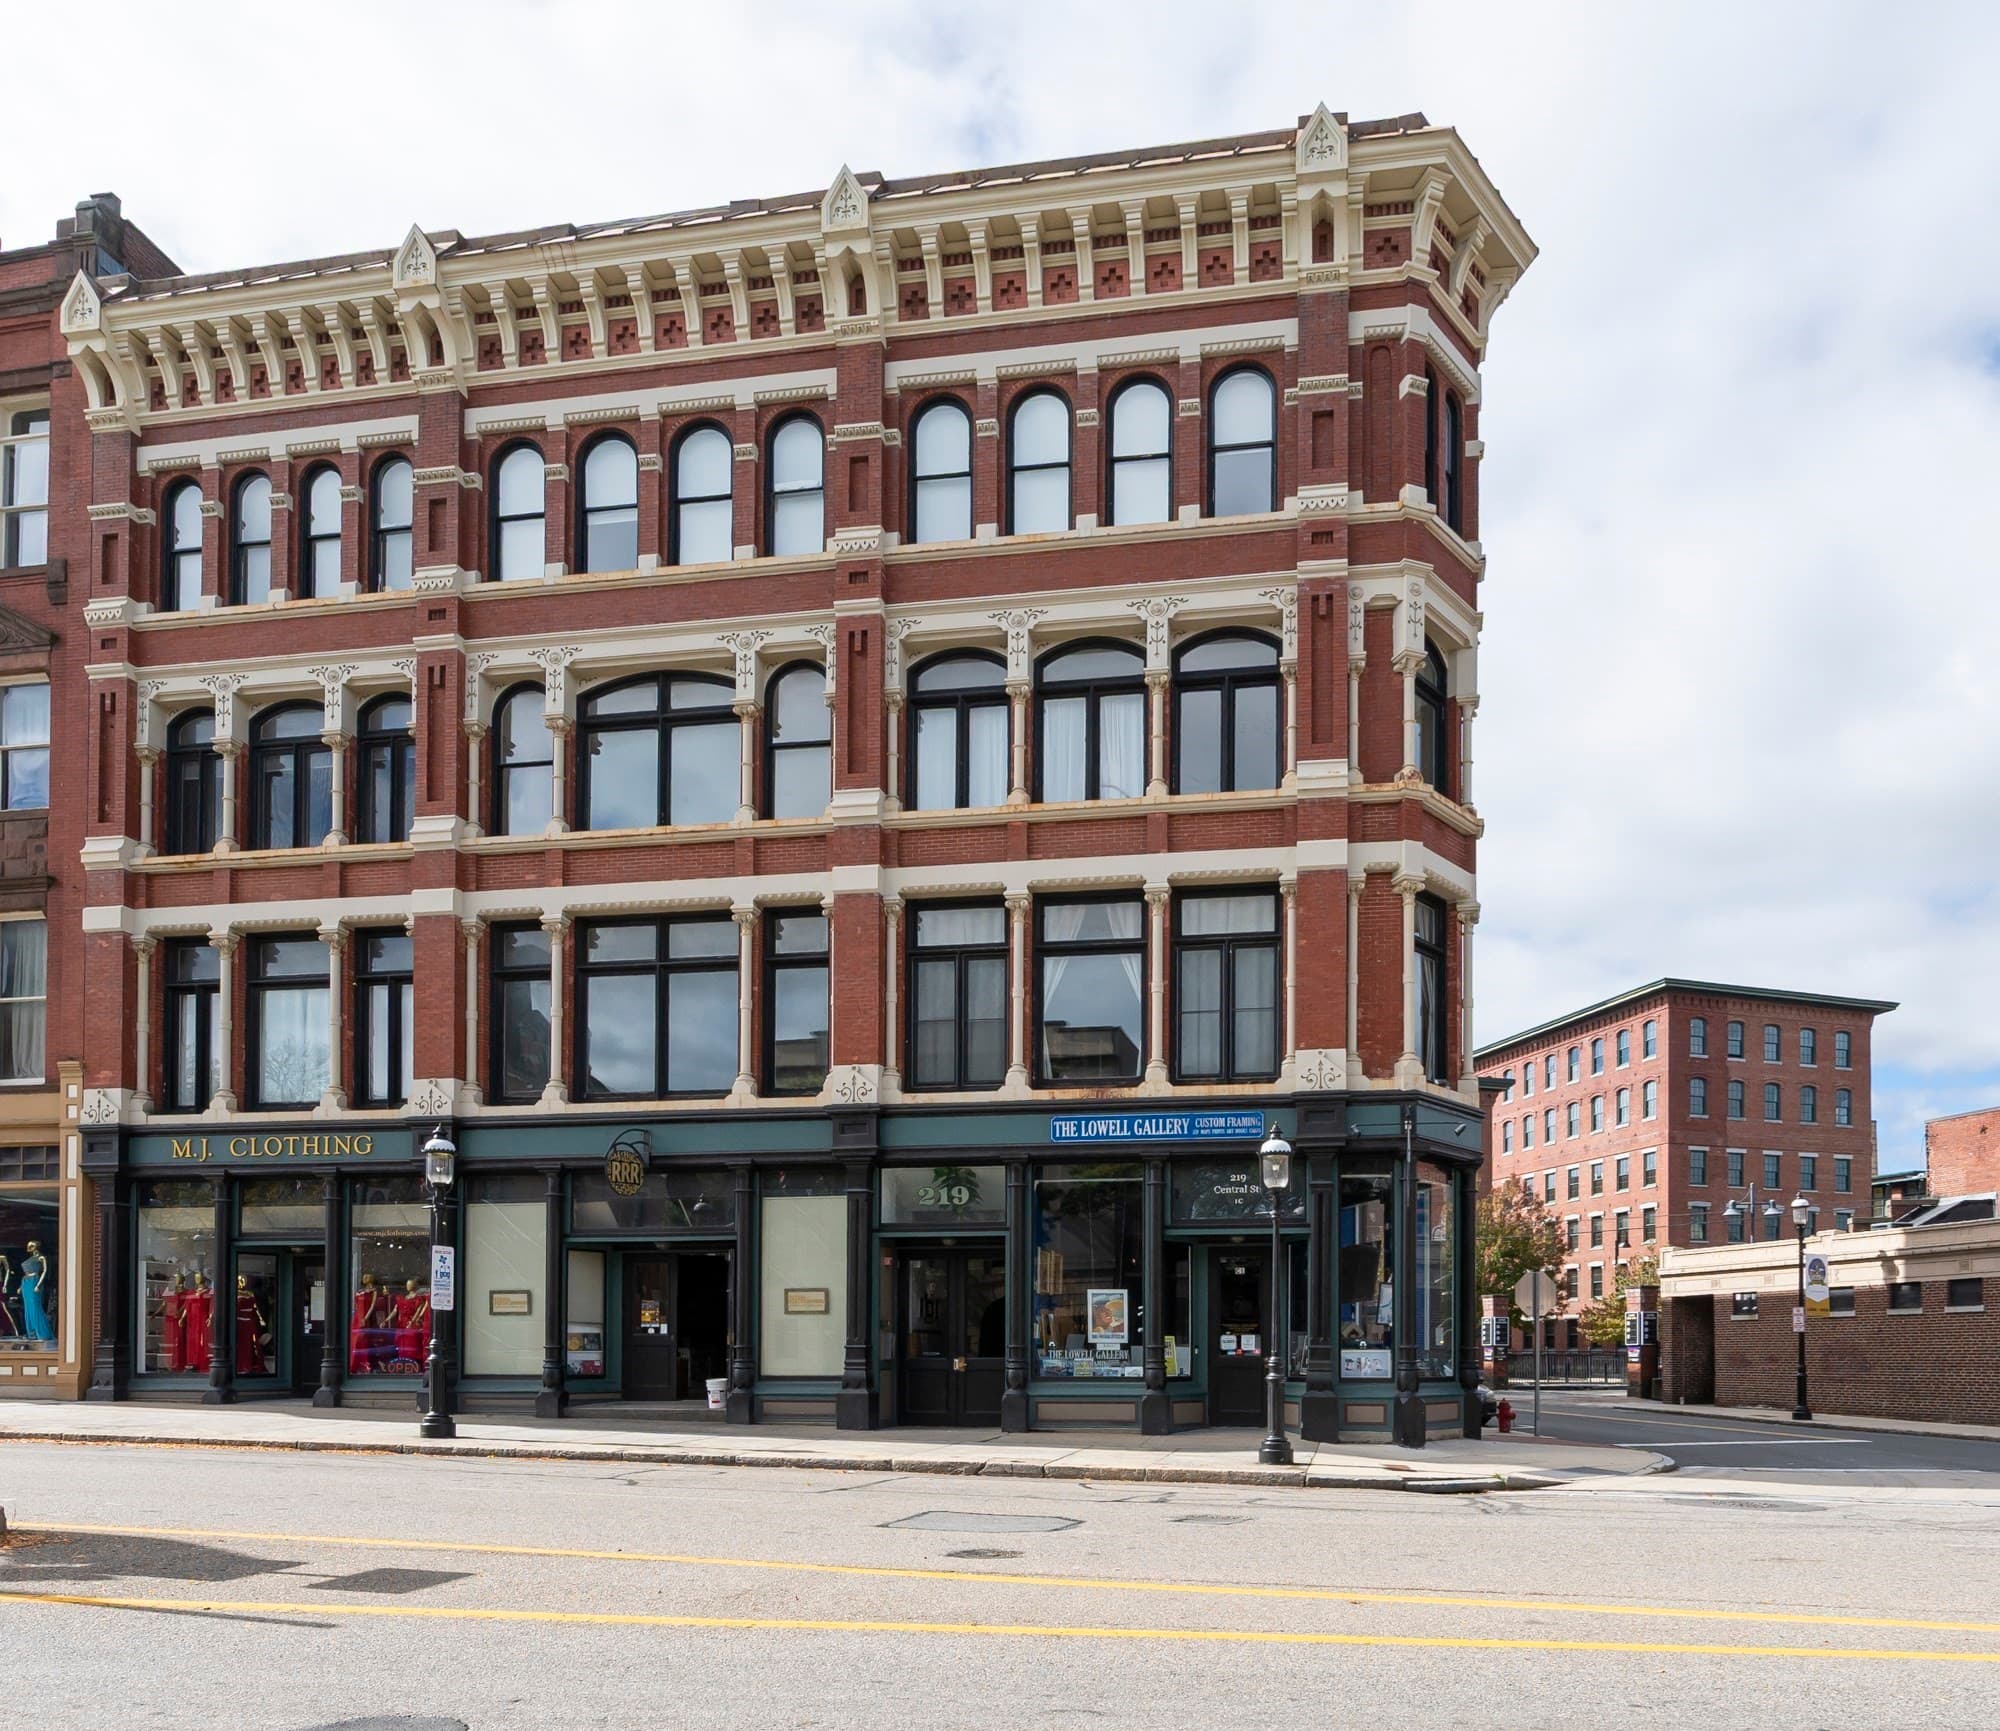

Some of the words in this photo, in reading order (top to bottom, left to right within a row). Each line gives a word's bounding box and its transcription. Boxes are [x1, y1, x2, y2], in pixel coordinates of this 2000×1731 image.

[1054, 1121, 1078, 1137] THE
[1081, 1119, 1131, 1137] LOWELL
[1133, 1118, 1190, 1135] GALLERY
[1195, 1117, 1225, 1128] CUSTOM
[1227, 1116, 1261, 1127] FRAMING
[171, 1137, 213, 1162] M.J.
[229, 1135, 374, 1157] CLOTHING
[611, 1161, 640, 1184] RRR
[1230, 1174, 1247, 1183] 219
[918, 1185, 970, 1205] 219
[1213, 1184, 1248, 1194] Central
[1048, 1350, 1065, 1360] THE
[1065, 1350, 1094, 1359] LOWELL
[1096, 1350, 1128, 1359] GALLERY
[387, 1363, 419, 1374] OPEN
